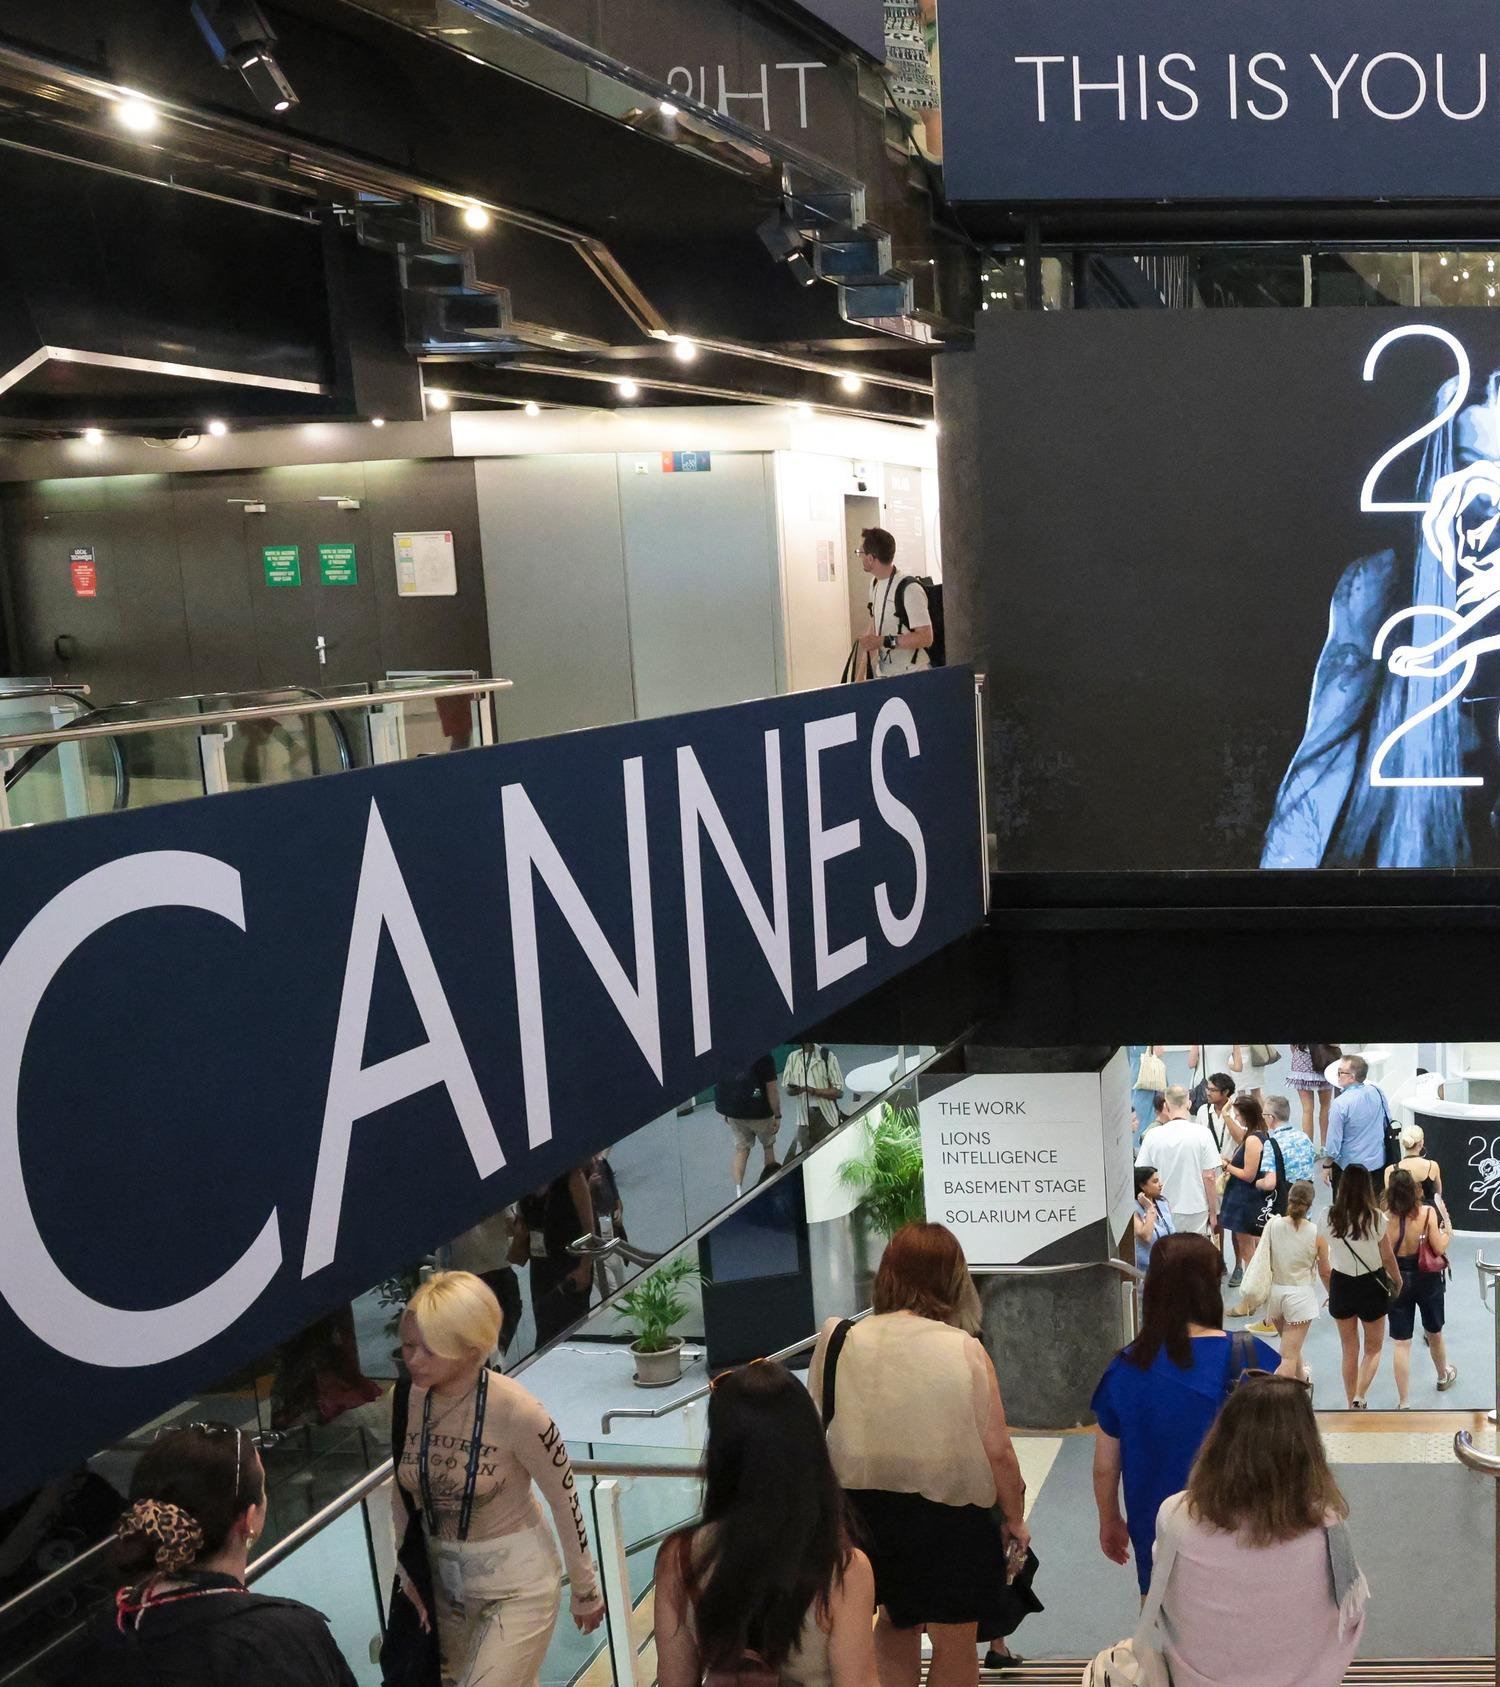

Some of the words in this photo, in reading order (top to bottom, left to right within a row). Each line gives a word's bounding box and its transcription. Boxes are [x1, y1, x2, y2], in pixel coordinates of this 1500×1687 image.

[1014, 53, 1199, 121] THIS
[1228, 52, 1289, 121] IS
[0, 697, 926, 1367] CANNES
[938, 1101, 971, 1115] THE
[974, 1101, 1026, 1115] WORK
[941, 1131, 991, 1145] LIONS
[942, 1150, 1058, 1165] INTELLIGENCE
[944, 1180, 1031, 1194] BASEMENT
[1034, 1179, 1087, 1193] STAGE
[946, 1209, 1031, 1223] SOLARIUM
[1035, 1205, 1077, 1222] CAFÉ
